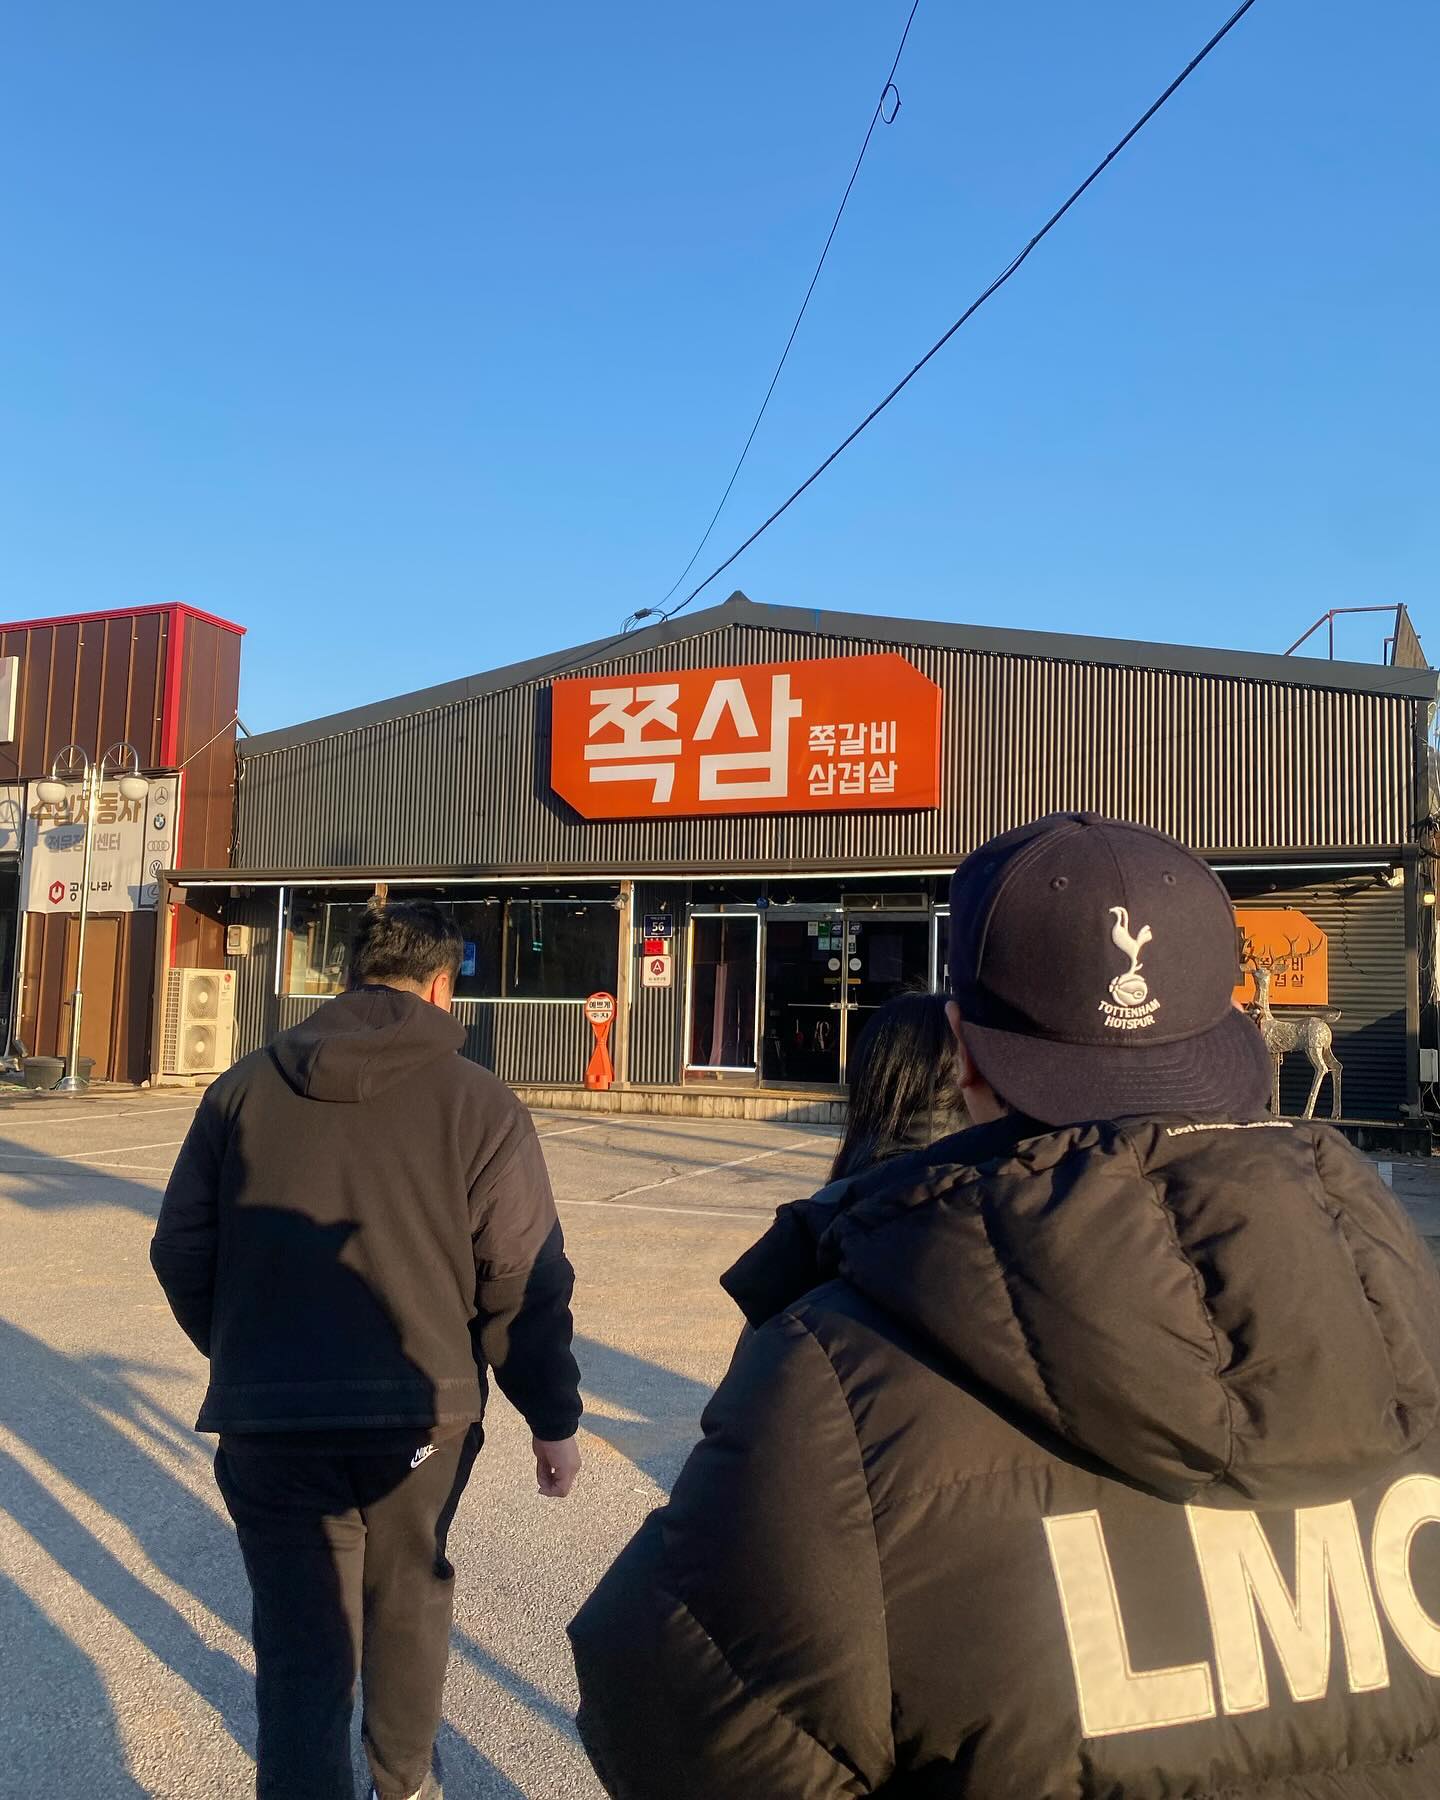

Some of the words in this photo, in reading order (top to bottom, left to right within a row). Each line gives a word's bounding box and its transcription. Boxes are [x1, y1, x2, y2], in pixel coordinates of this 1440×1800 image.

[583, 673, 803, 804] 쪽삼
[807, 720, 897, 757] 쪽갈비
[807, 759, 898, 796] 삼겹살
[69, 880, 113, 902] 공나라
[651, 921, 666, 932] 56
[1097, 998, 1161, 1018] TOTTENHAM
[1104, 1015, 1156, 1030] HOTSPUR
[414, 1443, 435, 1461] NIKE
